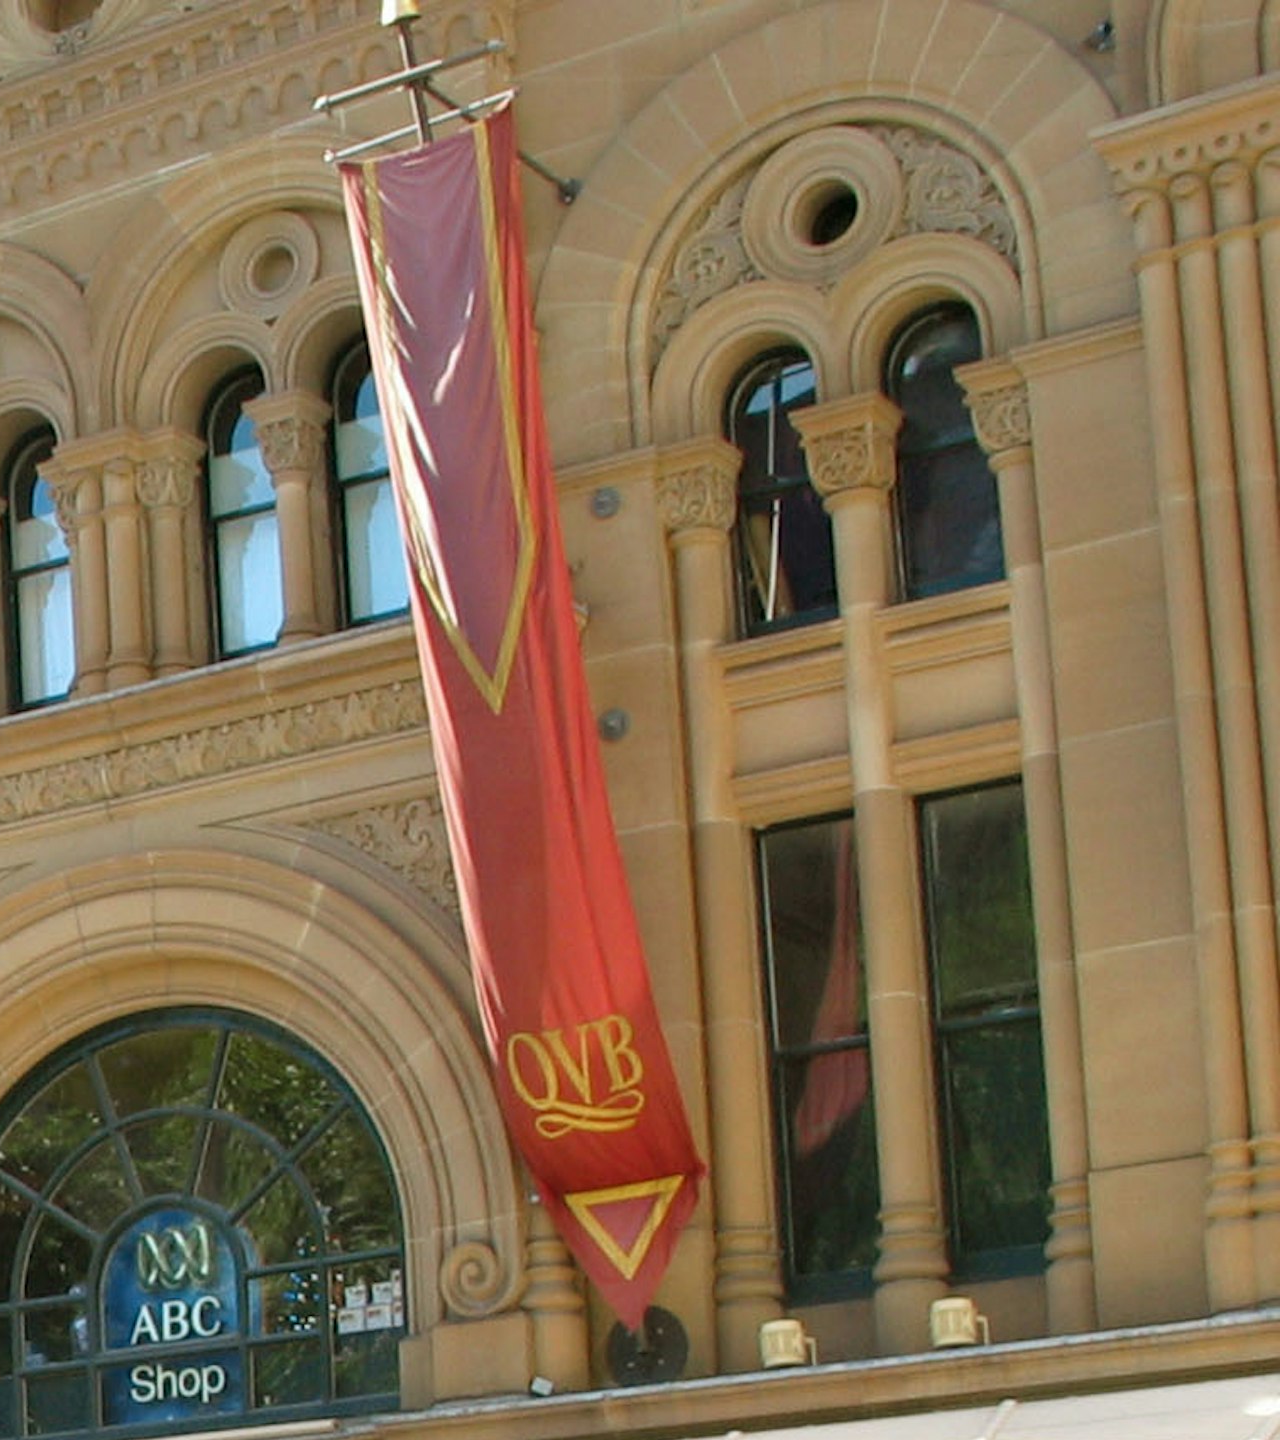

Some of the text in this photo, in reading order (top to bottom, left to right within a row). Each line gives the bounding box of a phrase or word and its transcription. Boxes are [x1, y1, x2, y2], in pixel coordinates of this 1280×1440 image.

[507, 1014, 644, 1138] QVB
[130, 1295, 221, 1345] ABC
[130, 1363, 225, 1403] Shop
